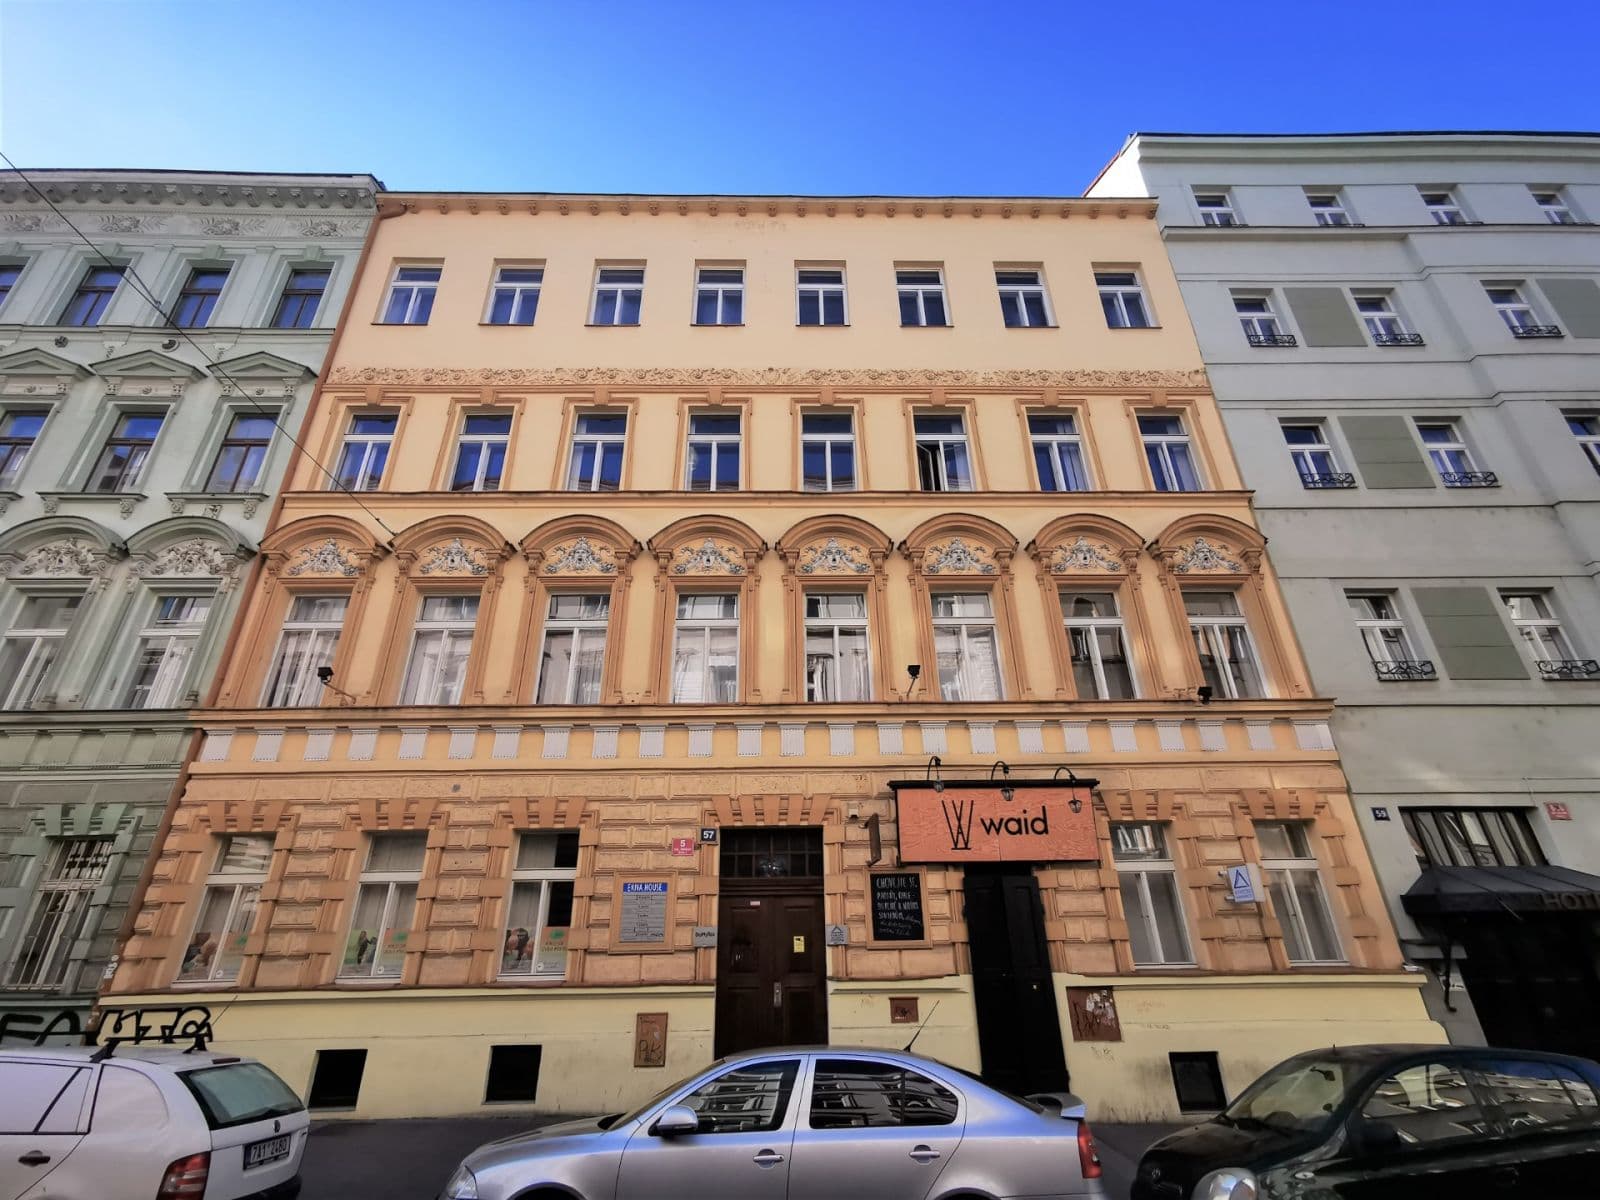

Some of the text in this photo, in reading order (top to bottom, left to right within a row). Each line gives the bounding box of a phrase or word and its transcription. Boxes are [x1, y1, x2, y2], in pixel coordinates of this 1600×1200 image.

[980, 805, 1049, 836] waid
[703, 830, 715, 840] 57
[680, 839, 686, 848] 5
